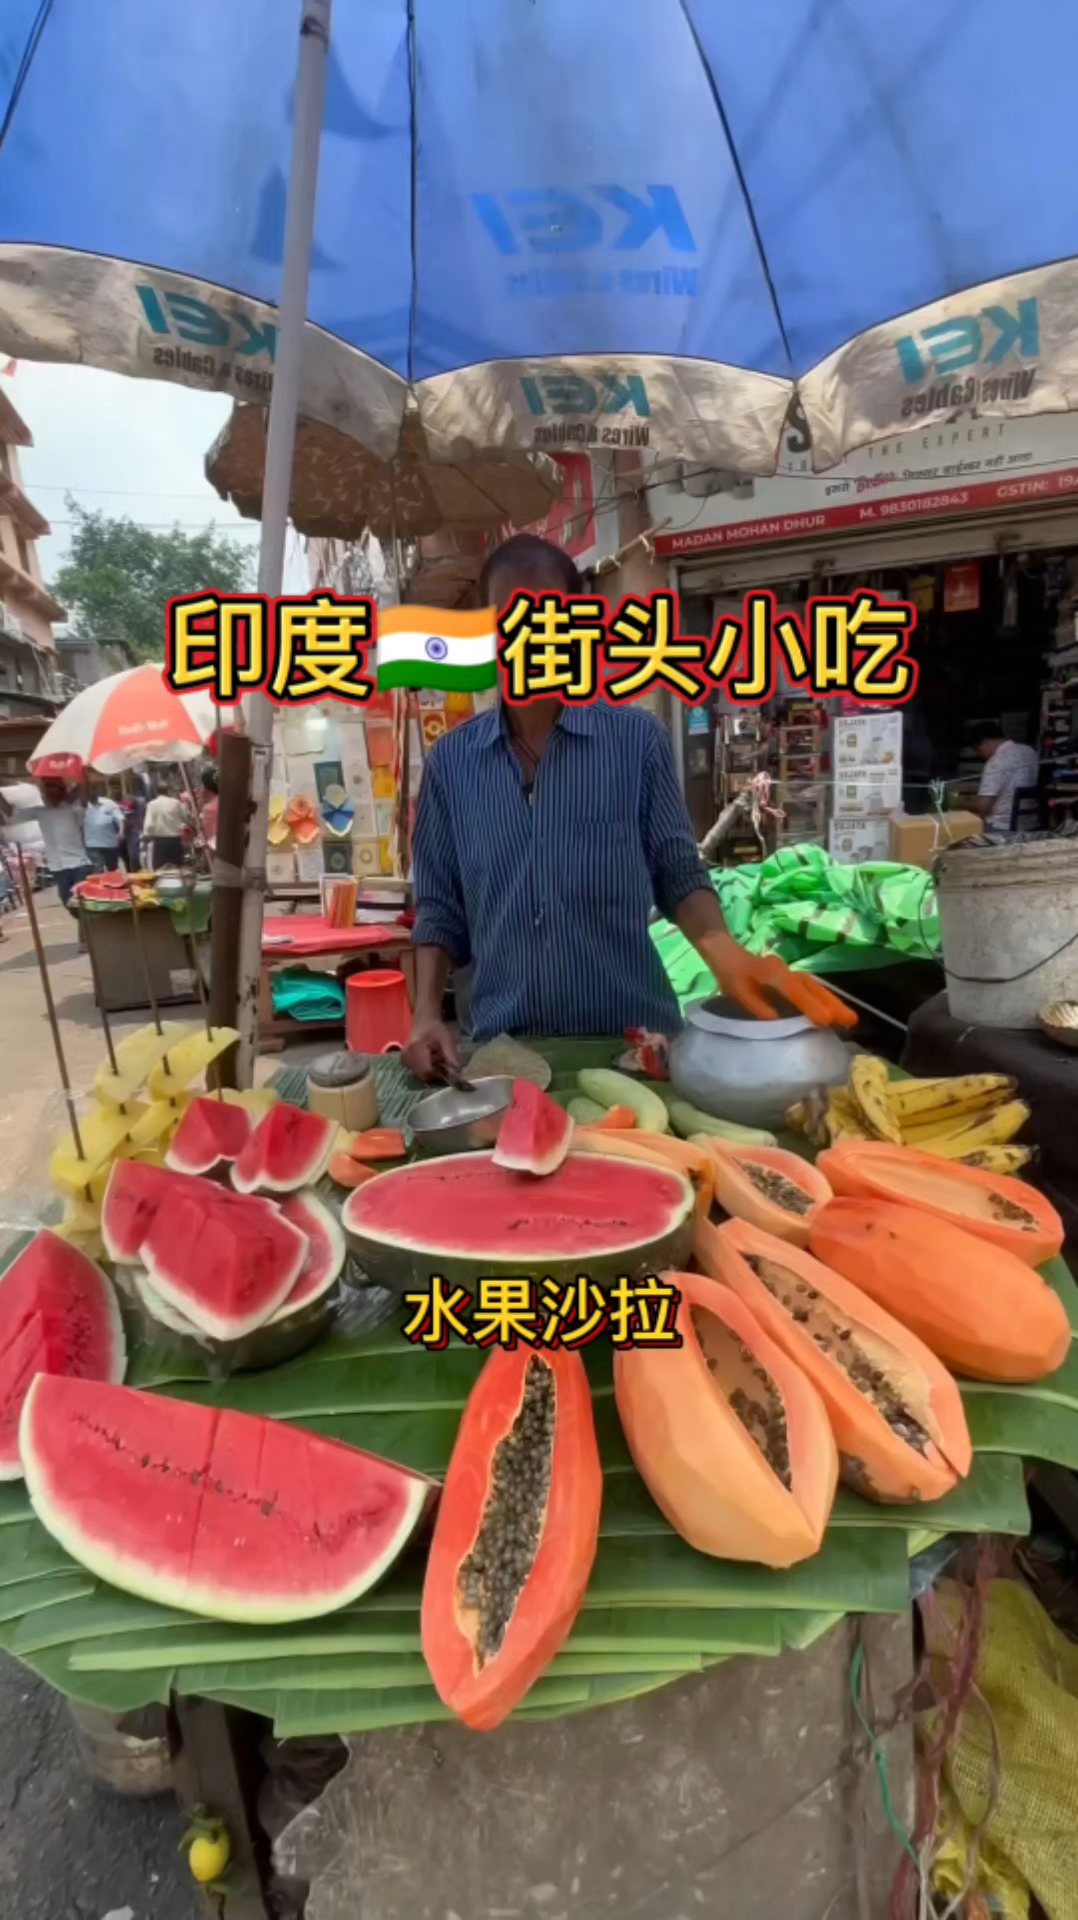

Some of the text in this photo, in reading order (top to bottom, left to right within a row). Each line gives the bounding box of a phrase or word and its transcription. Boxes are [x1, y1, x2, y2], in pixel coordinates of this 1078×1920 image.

[921, 422, 1005, 449] EXPERT
[672, 529, 723, 549] MADAN
[726, 520, 780, 541] MOHAN
[783, 514, 825, 532] DHUR
[859, 506, 877, 520] M.
[879, 490, 970, 516] 9830182843
